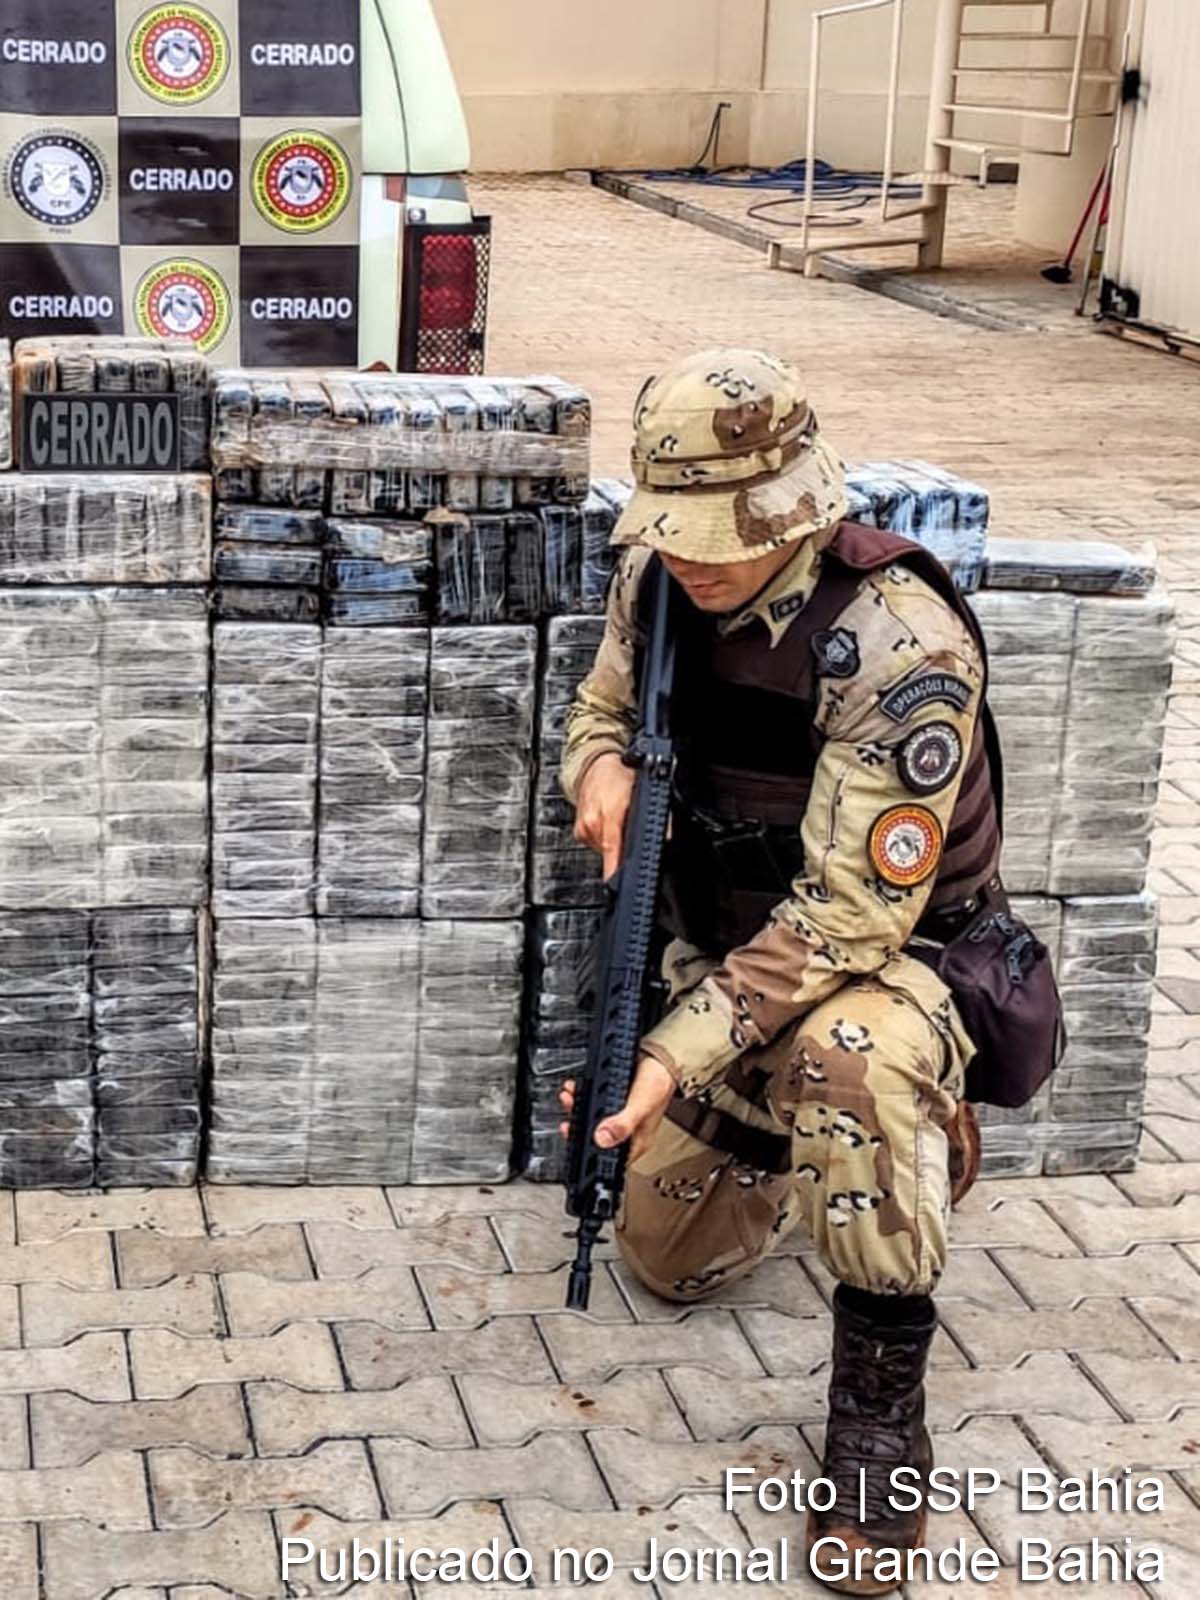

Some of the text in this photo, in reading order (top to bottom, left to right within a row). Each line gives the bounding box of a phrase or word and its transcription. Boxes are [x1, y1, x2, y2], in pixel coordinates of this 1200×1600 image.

[3, 39, 106, 63] CERRADO
[251, 43, 354, 66] CERRADO
[130, 169, 232, 190] CERRADO
[10, 296, 113, 317] CERRADO
[251, 298, 351, 319] CERRADO
[30, 401, 173, 465] CERRADO
